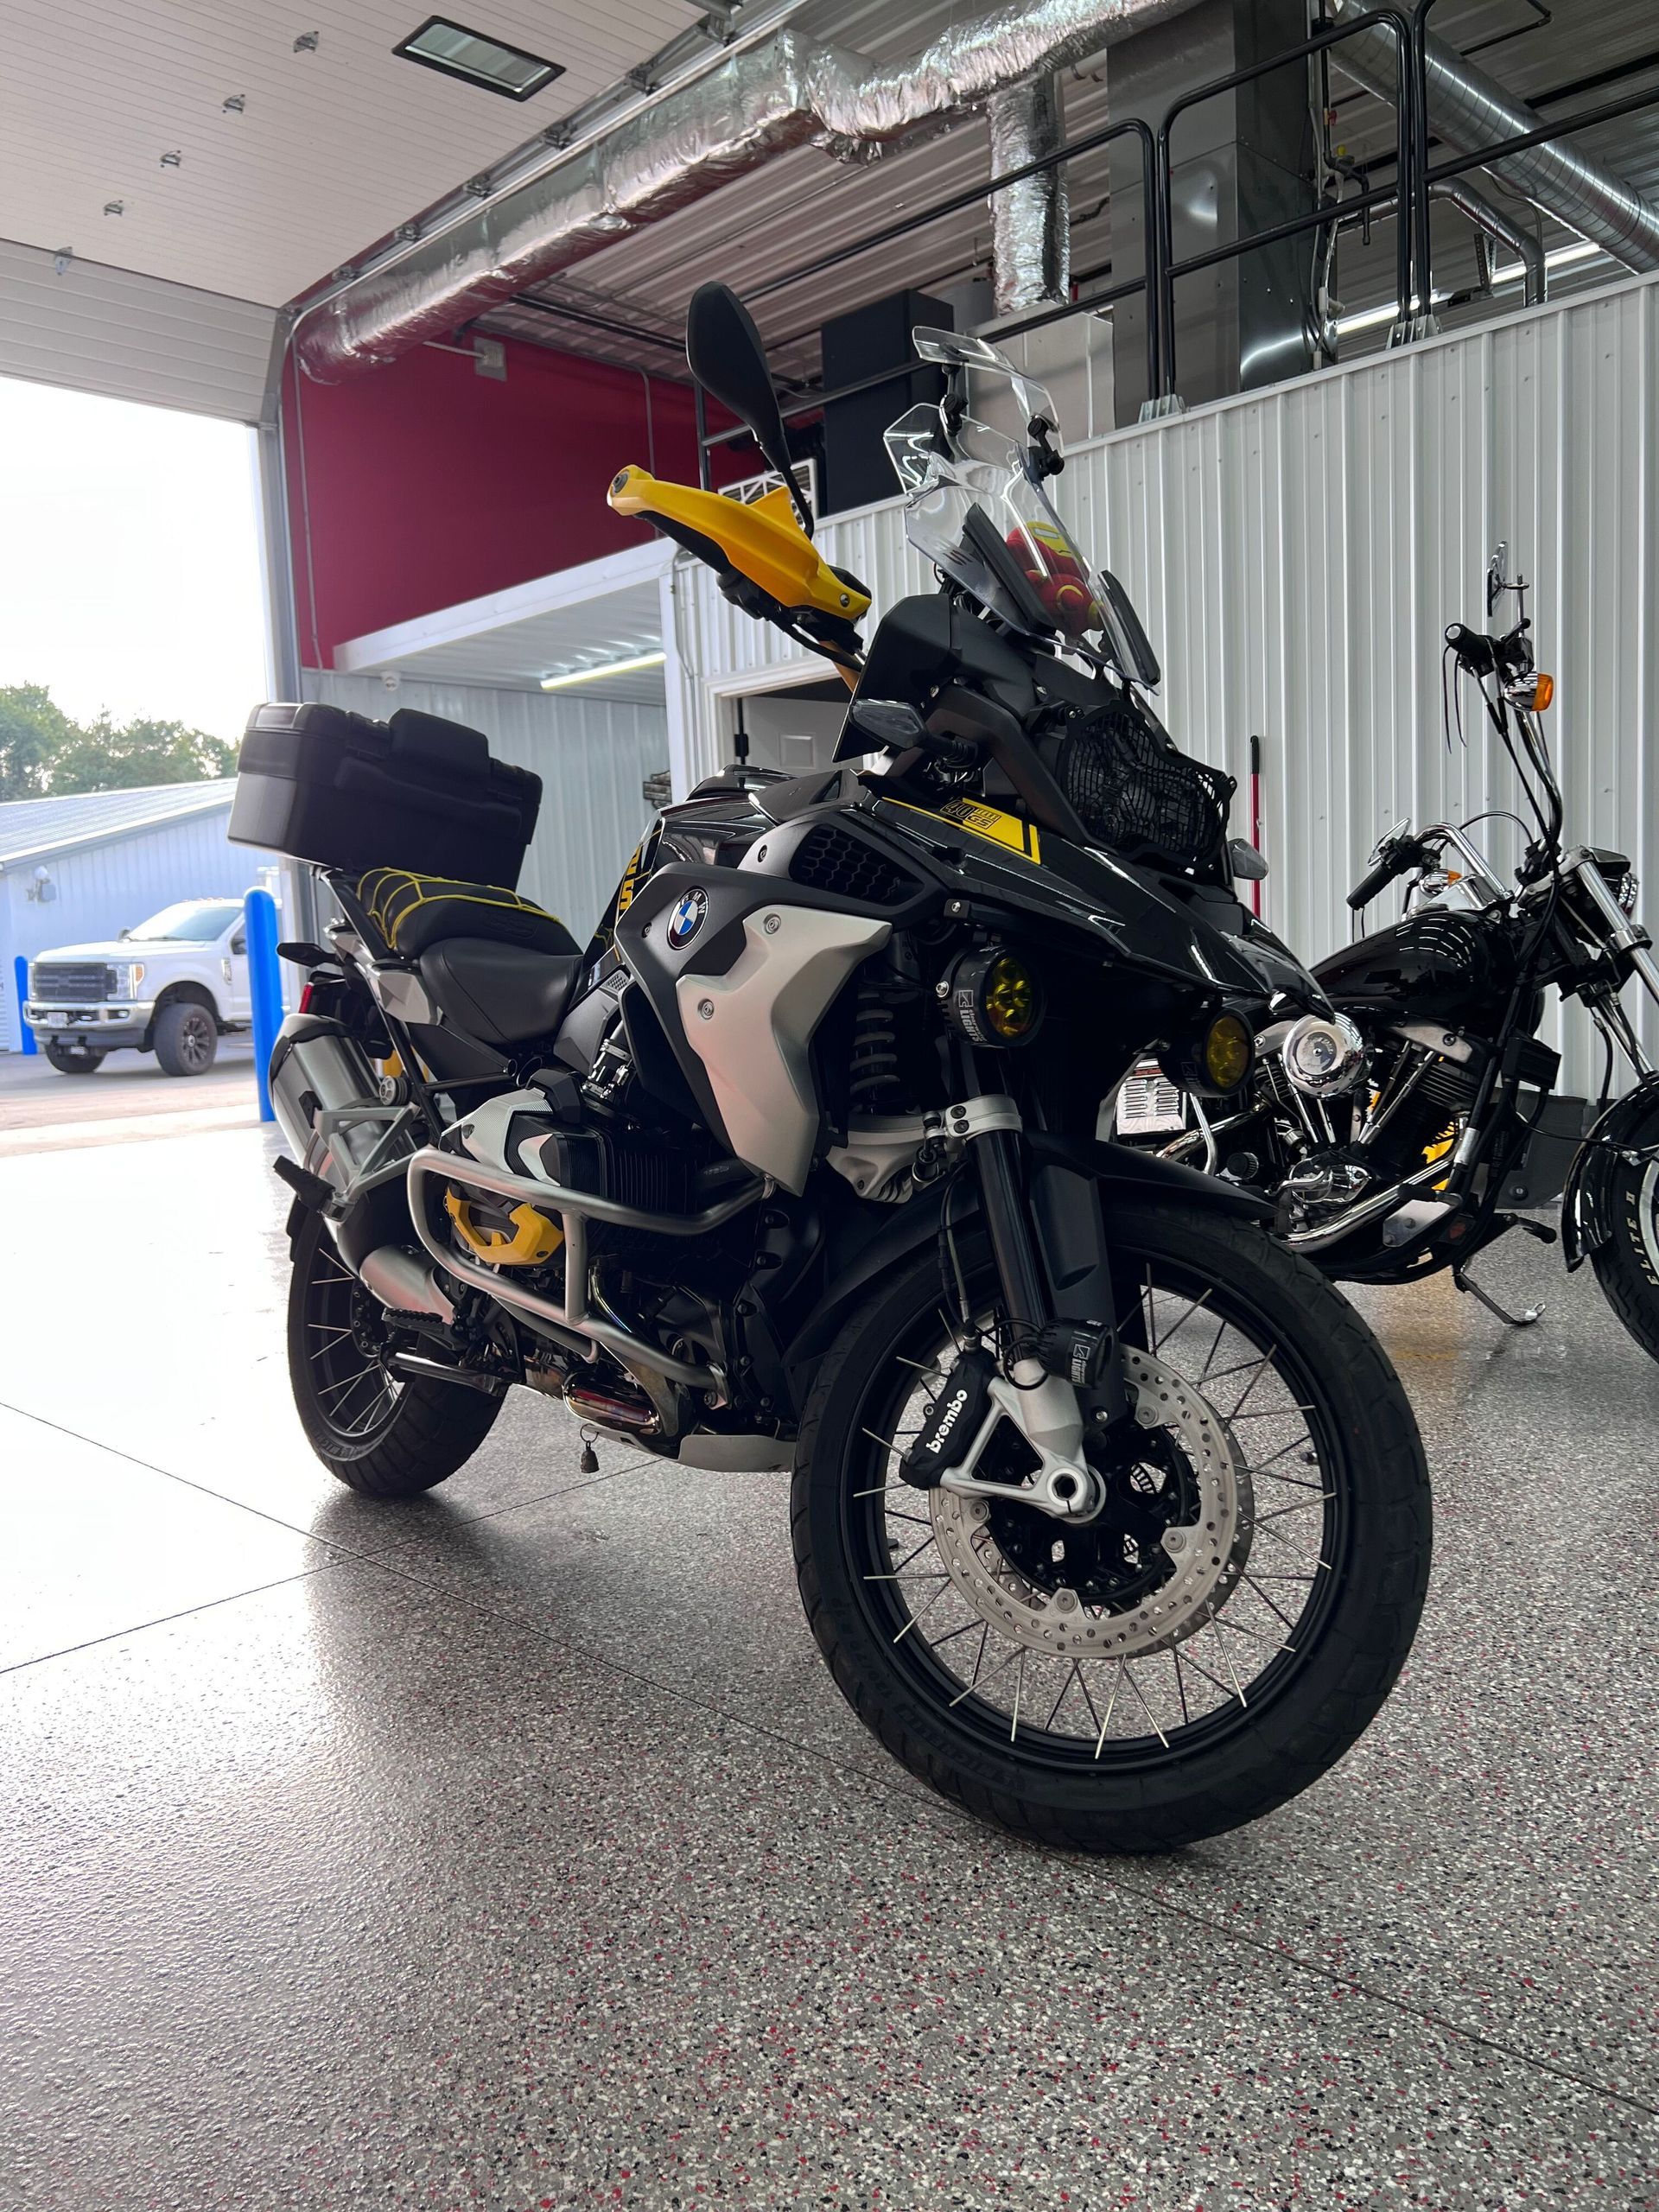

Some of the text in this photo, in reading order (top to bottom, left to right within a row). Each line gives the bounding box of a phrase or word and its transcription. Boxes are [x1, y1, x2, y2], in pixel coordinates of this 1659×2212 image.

[945, 802, 976, 818] 40
[969, 814, 992, 827] GS
[681, 891, 706, 914] BMW
[959, 1009, 982, 1042] LIGHTS
[1625, 1191, 1659, 1285] ELITE II
[925, 1389, 968, 1453] brembo
